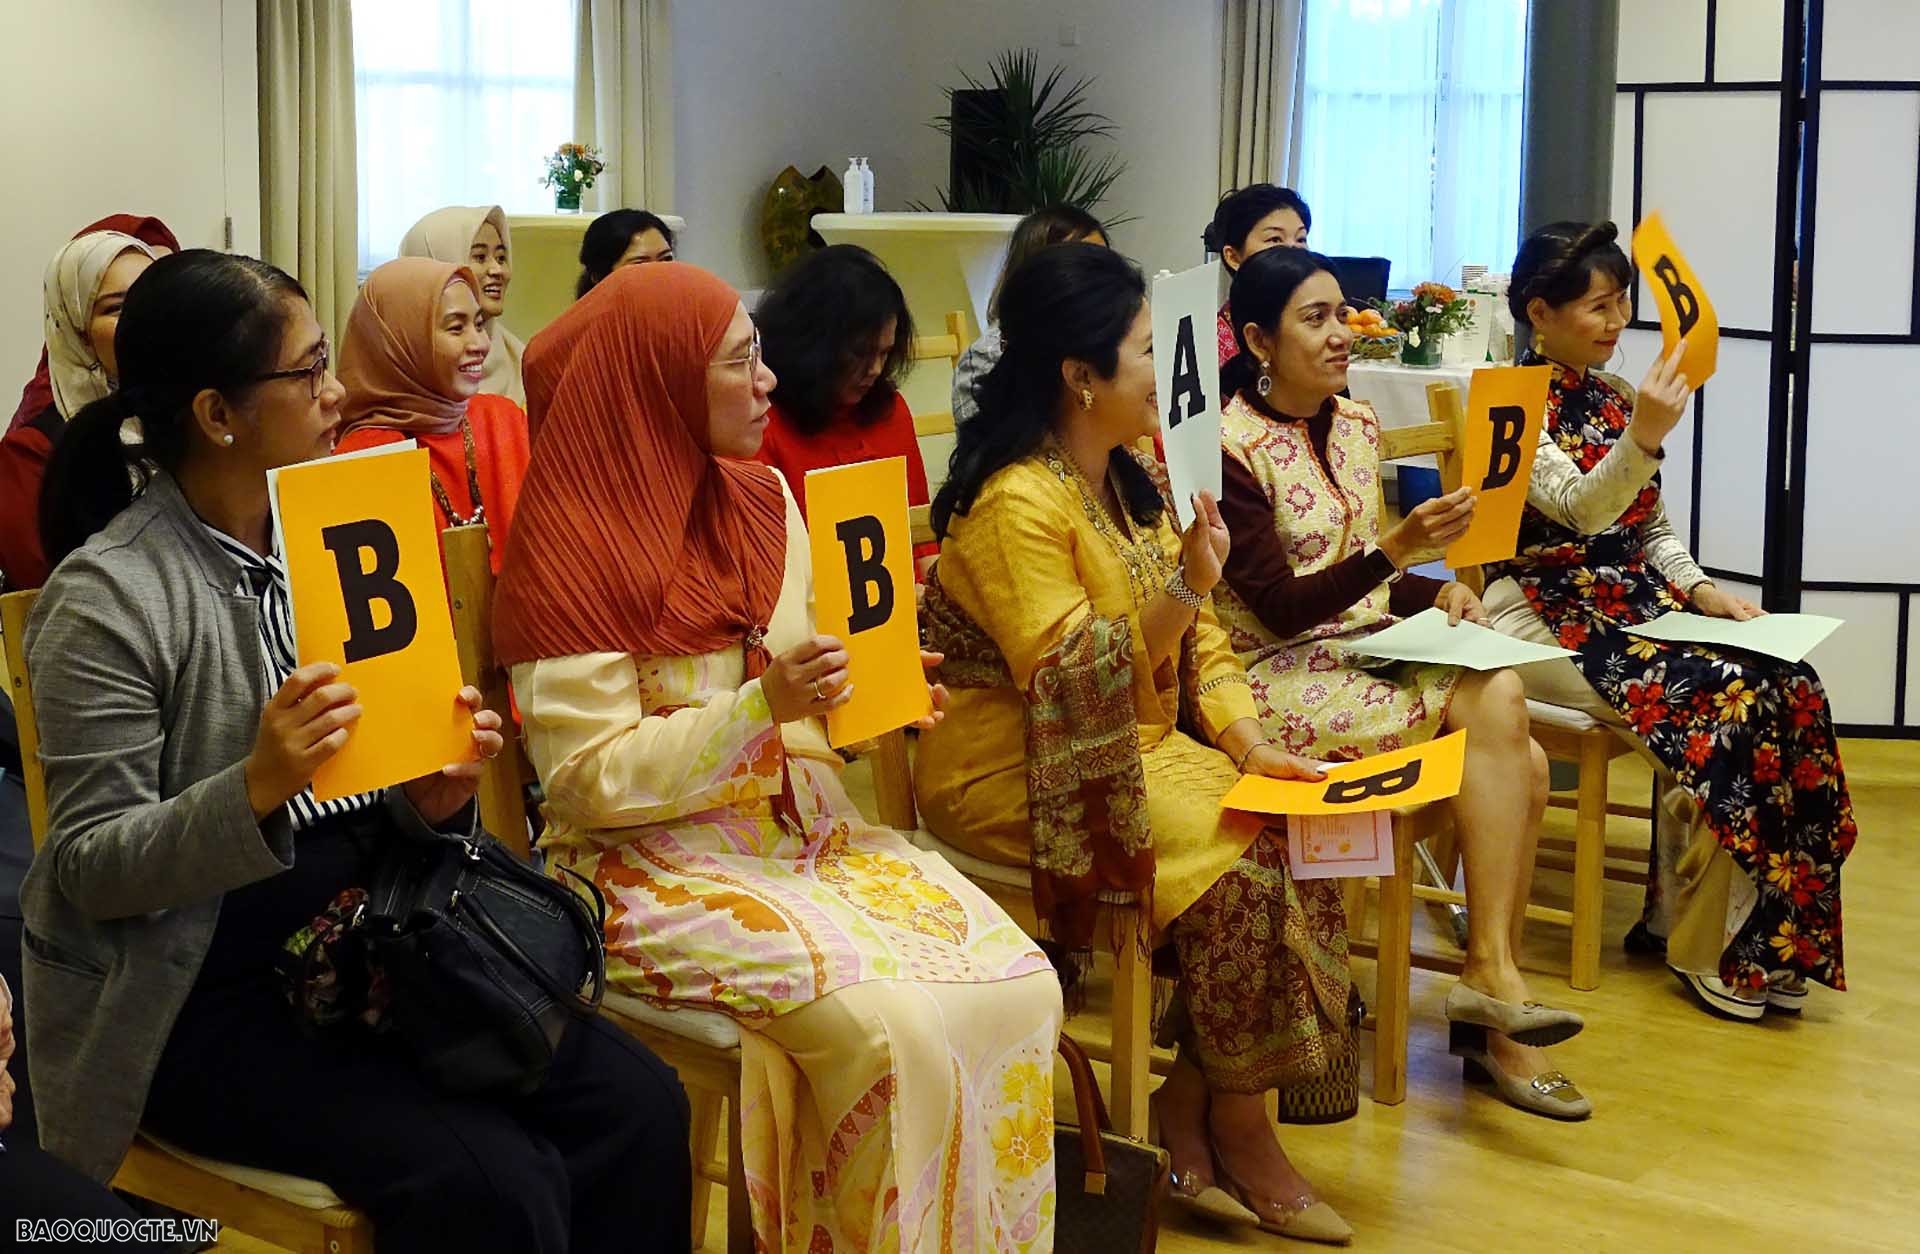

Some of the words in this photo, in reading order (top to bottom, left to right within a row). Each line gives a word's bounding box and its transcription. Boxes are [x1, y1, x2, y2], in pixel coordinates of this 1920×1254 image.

[1654, 254, 1699, 338] B
[1168, 314, 1205, 430] A
[1480, 405, 1525, 491] B
[322, 518, 417, 664] B
[836, 515, 894, 634] B
[1322, 758, 1422, 804] B
